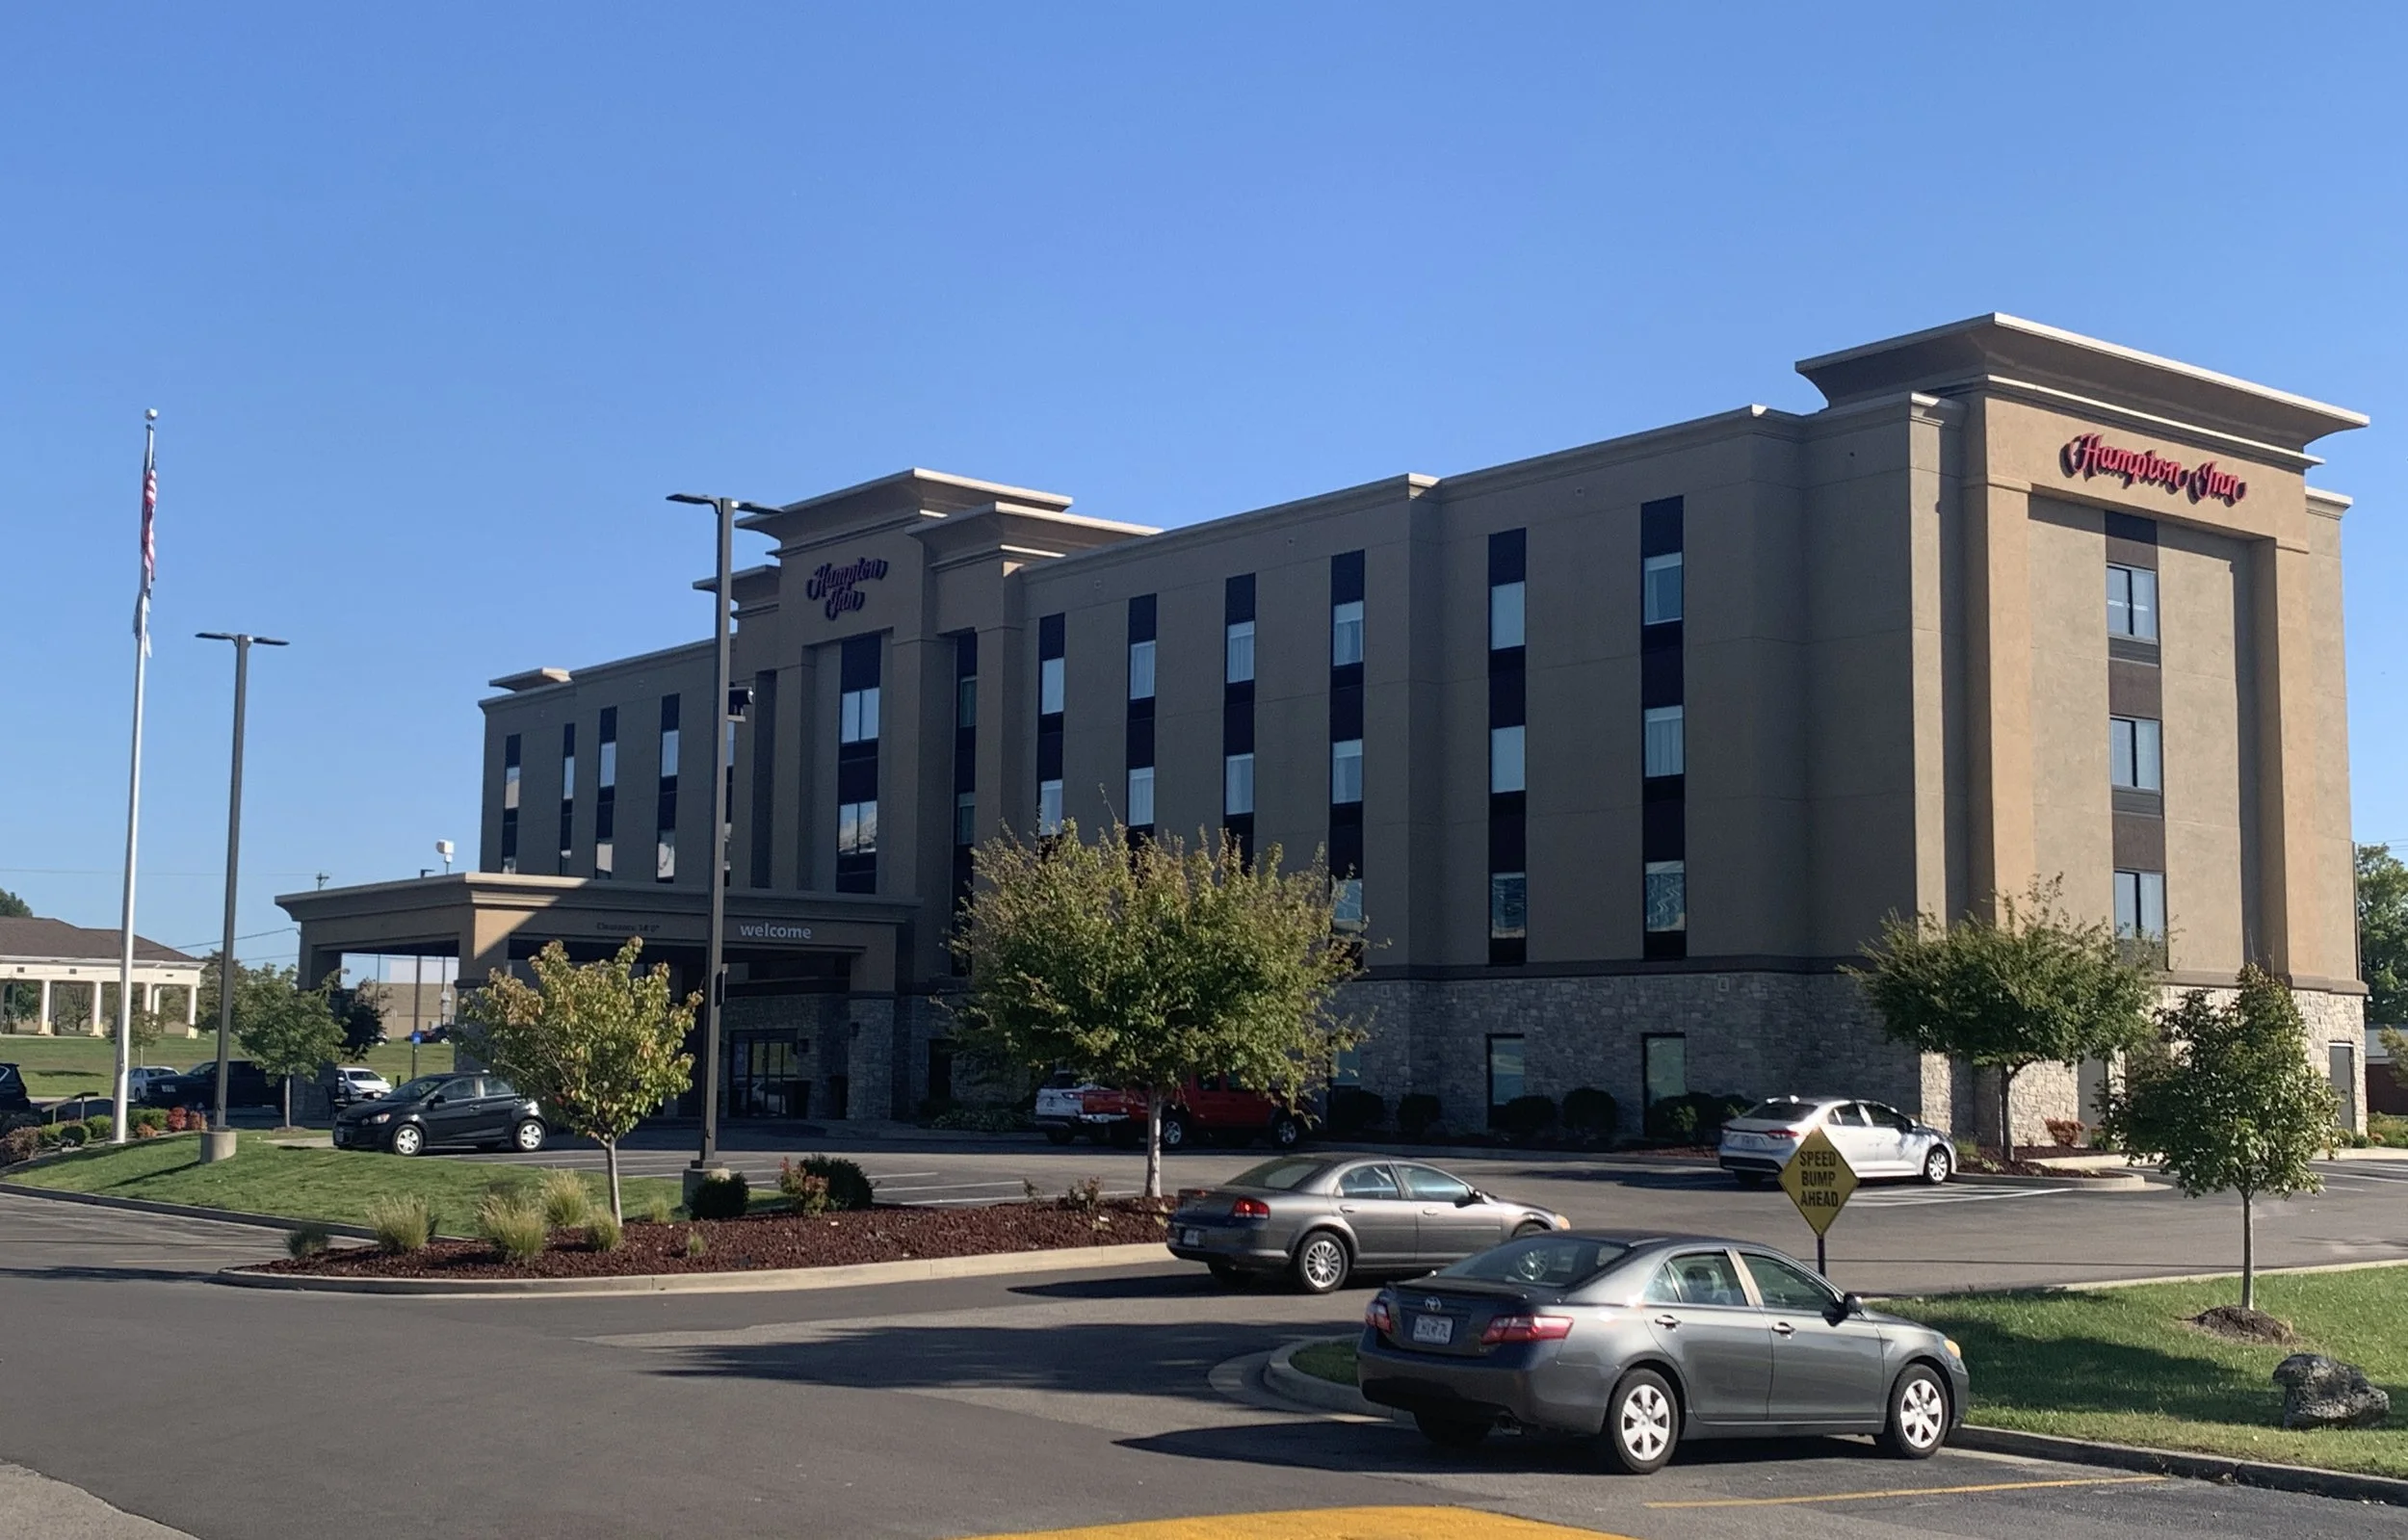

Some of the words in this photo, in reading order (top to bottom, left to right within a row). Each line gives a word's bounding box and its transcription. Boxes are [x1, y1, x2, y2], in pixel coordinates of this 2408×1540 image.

[2068, 432, 2190, 488] Hampton
[2195, 460, 2248, 503] Inn
[739, 922, 812, 939] welcome
[1799, 1151, 1837, 1168] SPEED
[1801, 1170, 1836, 1188] BUMP
[1800, 1190, 1839, 1208] AHEAD
